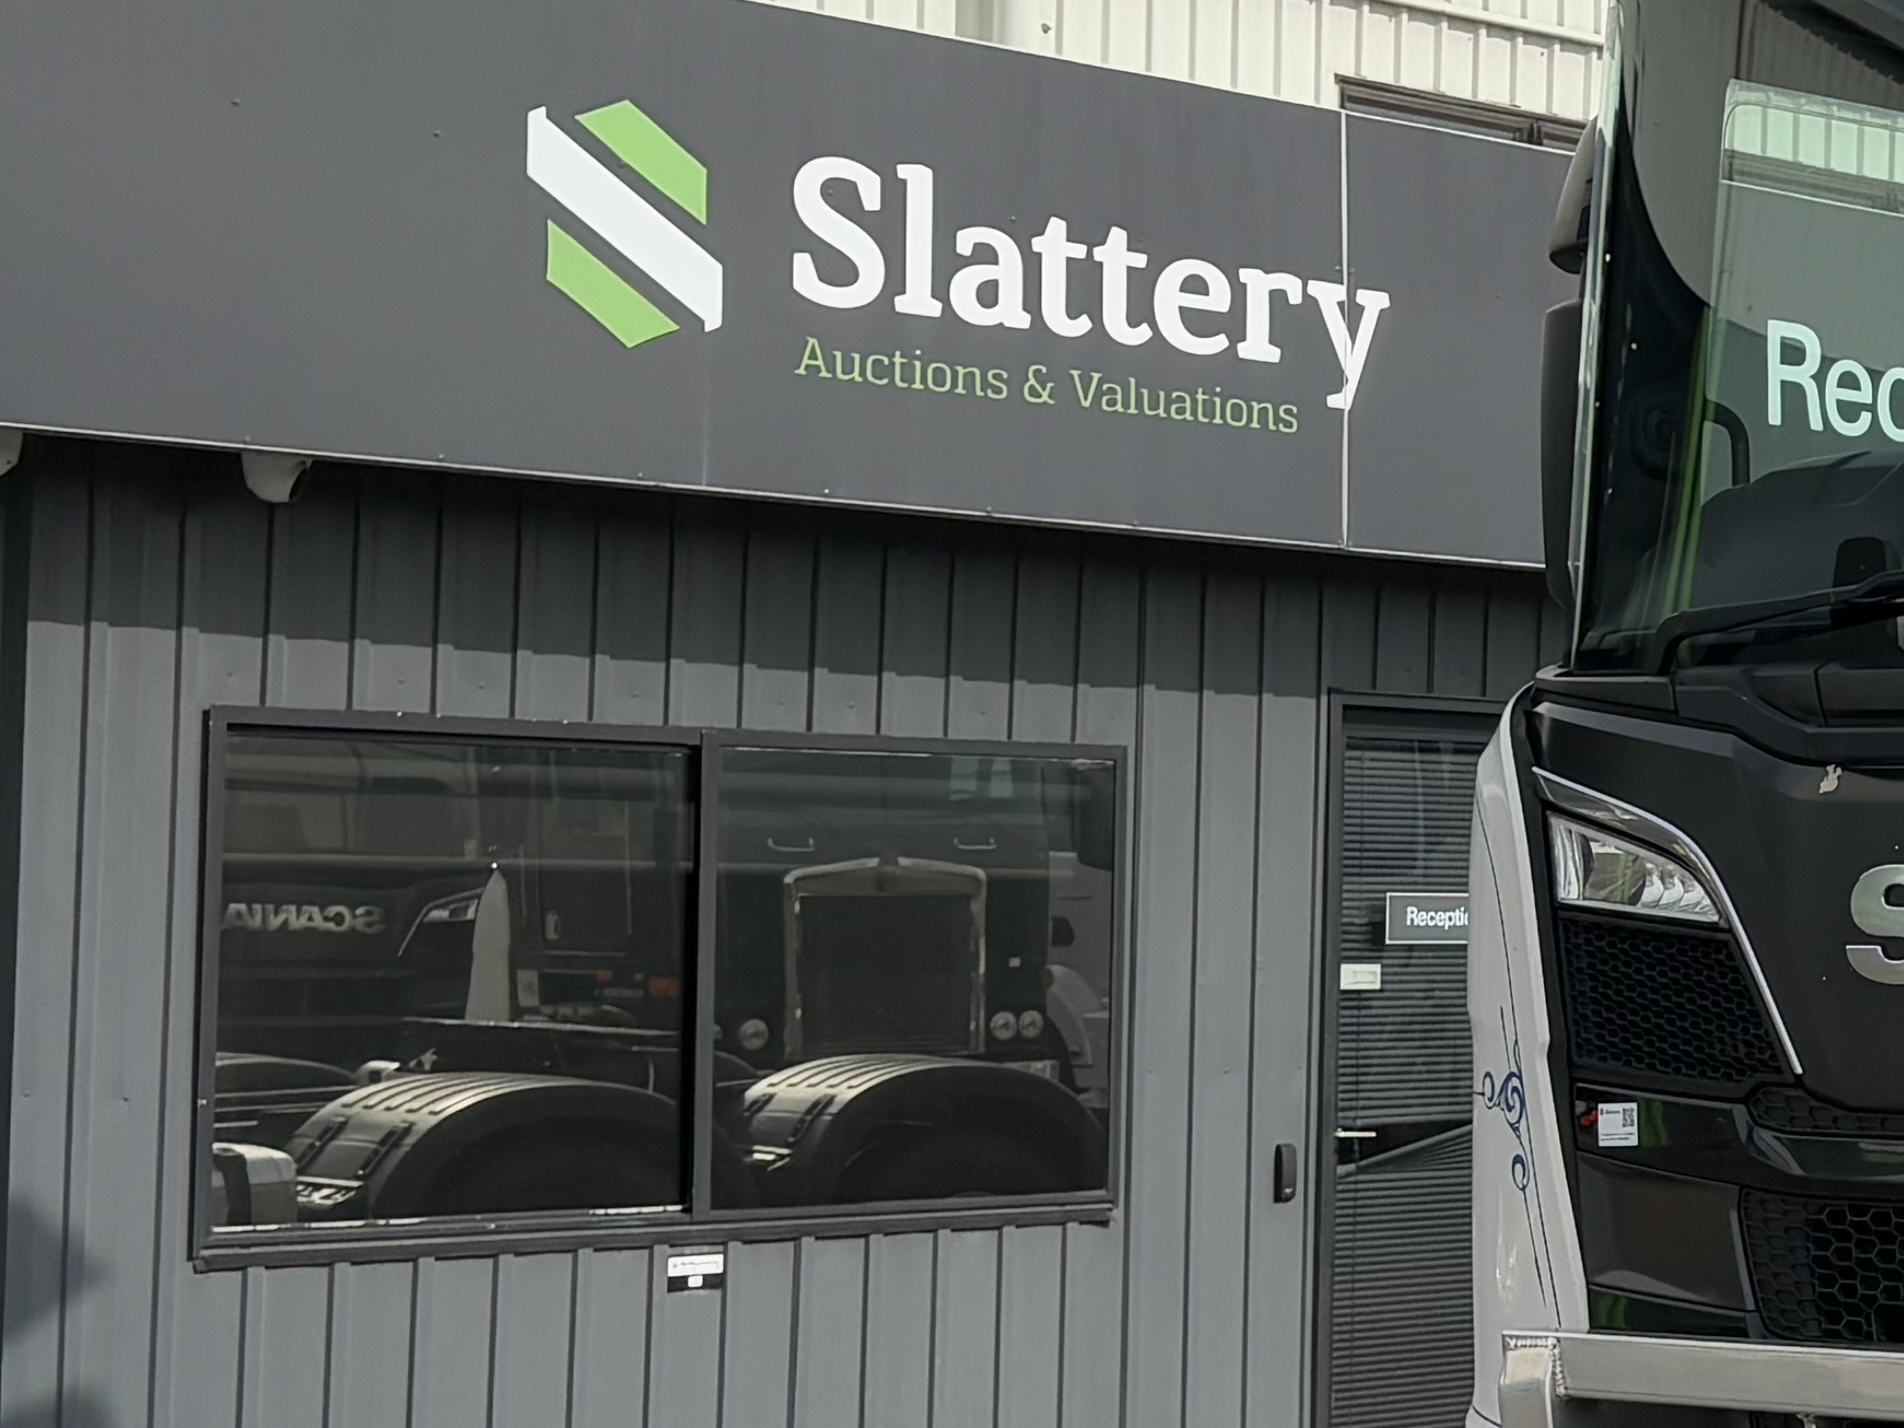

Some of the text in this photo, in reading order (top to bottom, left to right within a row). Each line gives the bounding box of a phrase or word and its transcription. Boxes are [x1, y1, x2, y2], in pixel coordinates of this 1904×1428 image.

[791, 155, 1391, 411] Slattery
[793, 336, 1300, 435] Auctions & Valuations
[1406, 906, 1468, 930] Recepti
